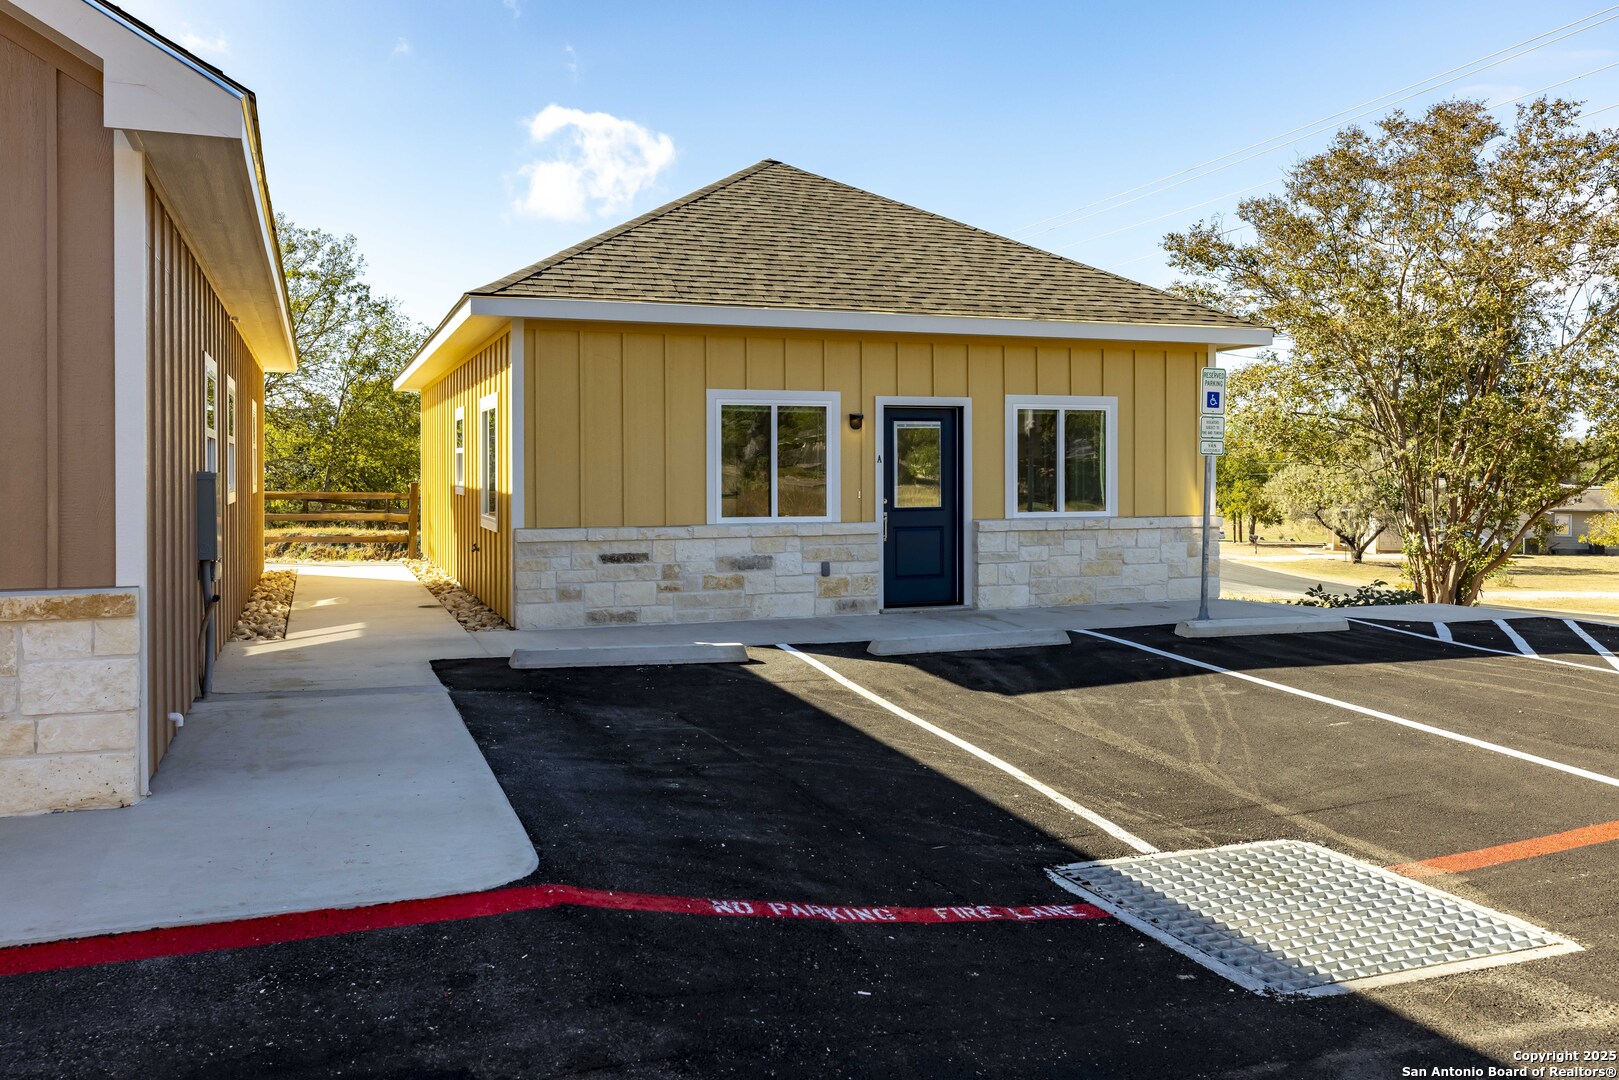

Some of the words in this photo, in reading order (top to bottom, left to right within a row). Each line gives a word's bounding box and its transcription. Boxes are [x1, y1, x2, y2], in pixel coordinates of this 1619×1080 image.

[877, 454, 883, 464] A
[711, 899, 754, 914] NO
[768, 902, 897, 921] PARKING
[932, 905, 1002, 920] FIRE
[1007, 905, 1087, 920] LANE
